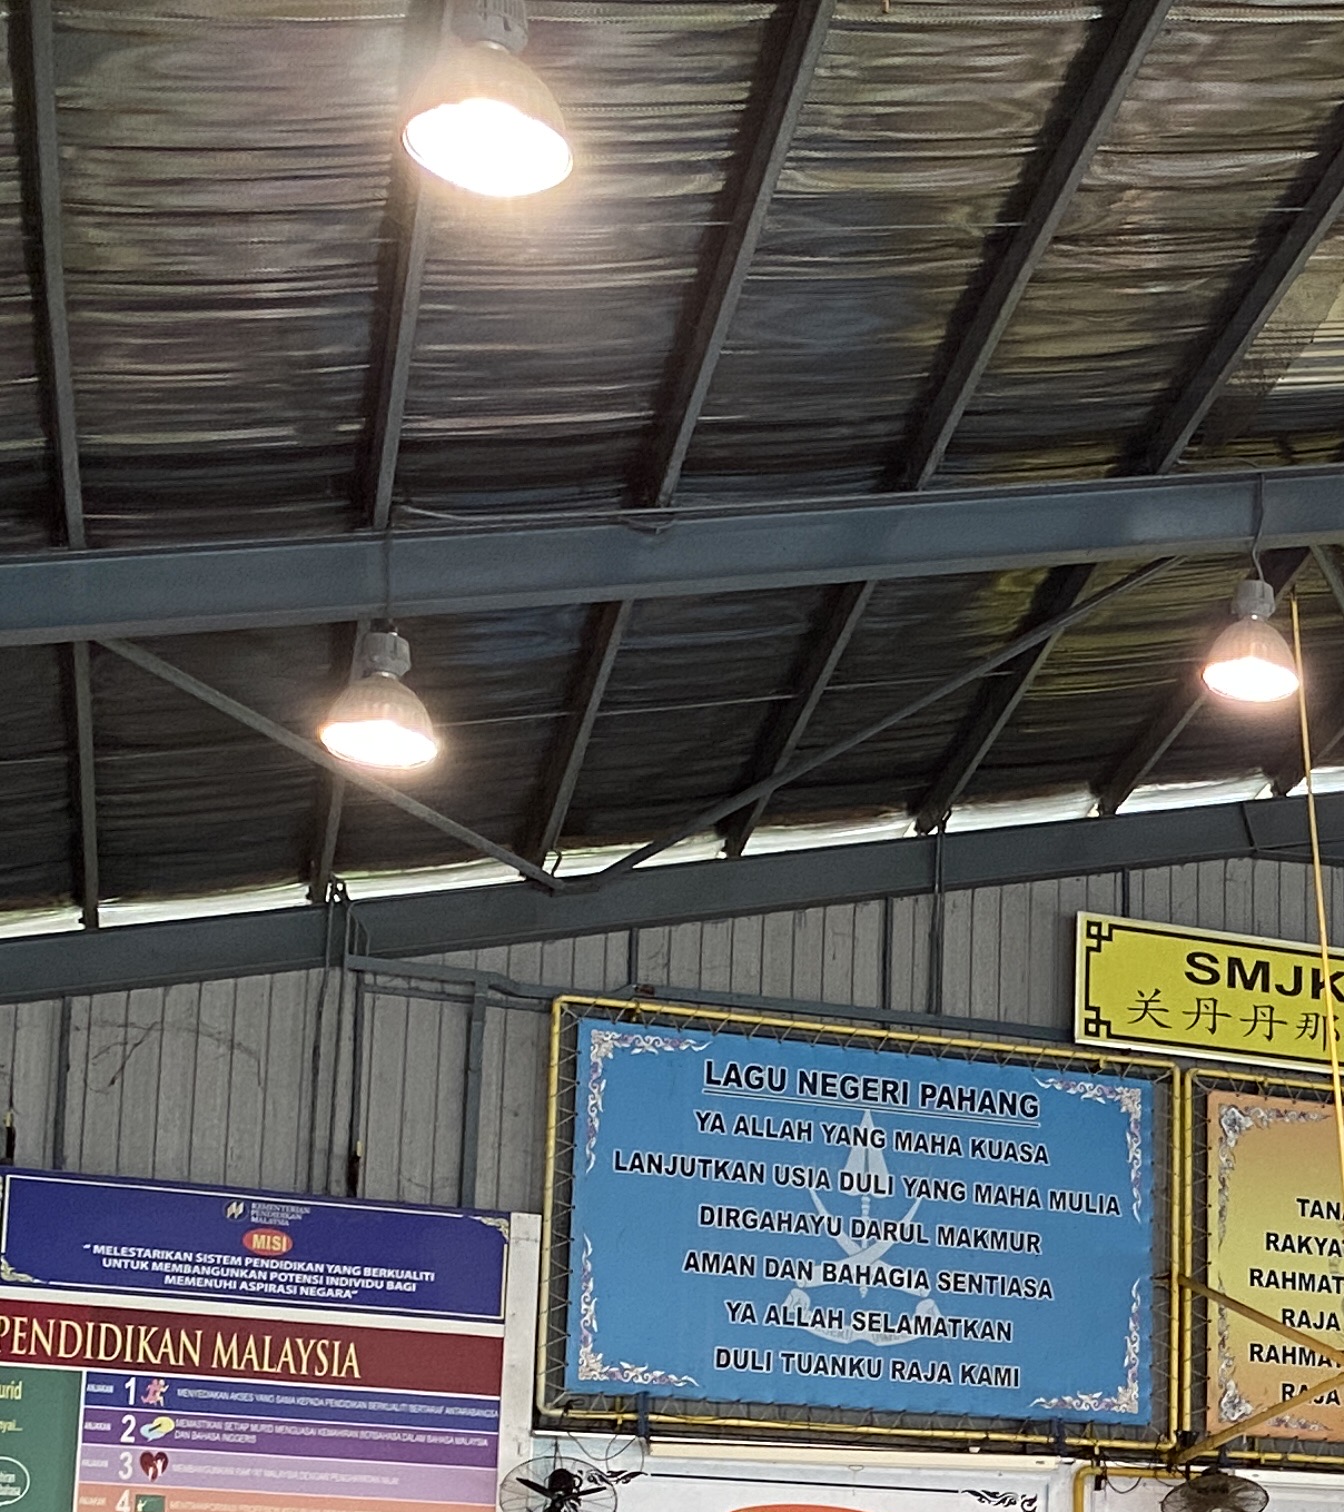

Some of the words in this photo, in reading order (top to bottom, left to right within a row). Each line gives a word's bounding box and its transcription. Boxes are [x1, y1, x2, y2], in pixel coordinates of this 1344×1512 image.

[706, 1060, 786, 1091] LAGU
[799, 1070, 908, 1104] NEGERI
[921, 1084, 1037, 1117] PAHANG
[696, 1111, 725, 1133] YA
[734, 1115, 811, 1141] ALLAH
[822, 1124, 885, 1148] YANG
[895, 1131, 962, 1156] MAHA
[971, 1138, 1048, 1164] KUASA
[615, 1151, 764, 1183] LANJUTKAN
[775, 1165, 830, 1189] USIA
[840, 1171, 893, 1195] DULI
[903, 1177, 965, 1201] YANG
[975, 1184, 1040, 1208] MAHA
[1050, 1191, 1120, 1215] MULIA
[252, 1234, 288, 1253] MISI
[700, 1205, 841, 1236] DIRGAHAYU
[851, 1218, 928, 1243] DARUL
[938, 1226, 1039, 1253] MAKMUR
[102, 1257, 148, 1271] UNTUK
[151, 1261, 267, 1281] MEMBANGUNKAN
[269, 1271, 324, 1286] POTENSI
[326, 1275, 384, 1290] INDIVIDU
[386, 1279, 417, 1293] BAGI
[164, 1274, 237, 1290] MEMENUHI
[239, 1280, 298, 1295] ASPIRASI
[195, 1252, 242, 1265] SISTEM
[245, 1257, 324, 1273] PENDIDIKAN
[326, 1263, 361, 1276] YANG
[363, 1266, 435, 1282] BERKUALITI
[684, 1252, 754, 1275] AMAN
[765, 1258, 812, 1280] DAN
[823, 1262, 929, 1289] BAHAGIA
[937, 1272, 1052, 1298] SENTIASA
[1249, 1268, 1344, 1294] RAHMAT
[726, 1302, 755, 1323] YA
[765, 1305, 842, 1329] ALLAH
[852, 1311, 1010, 1341] SELAMATKAN
[211, 1331, 361, 1378] MALAYSIA
[716, 1348, 771, 1371] DULI
[781, 1353, 881, 1378] TUANKU
[891, 1360, 951, 1382] RAJA
[961, 1364, 1018, 1386] KAMI
[125, 1377, 136, 1405] 1
[120, 1414, 136, 1443] 2
[118, 1451, 133, 1480] 3
